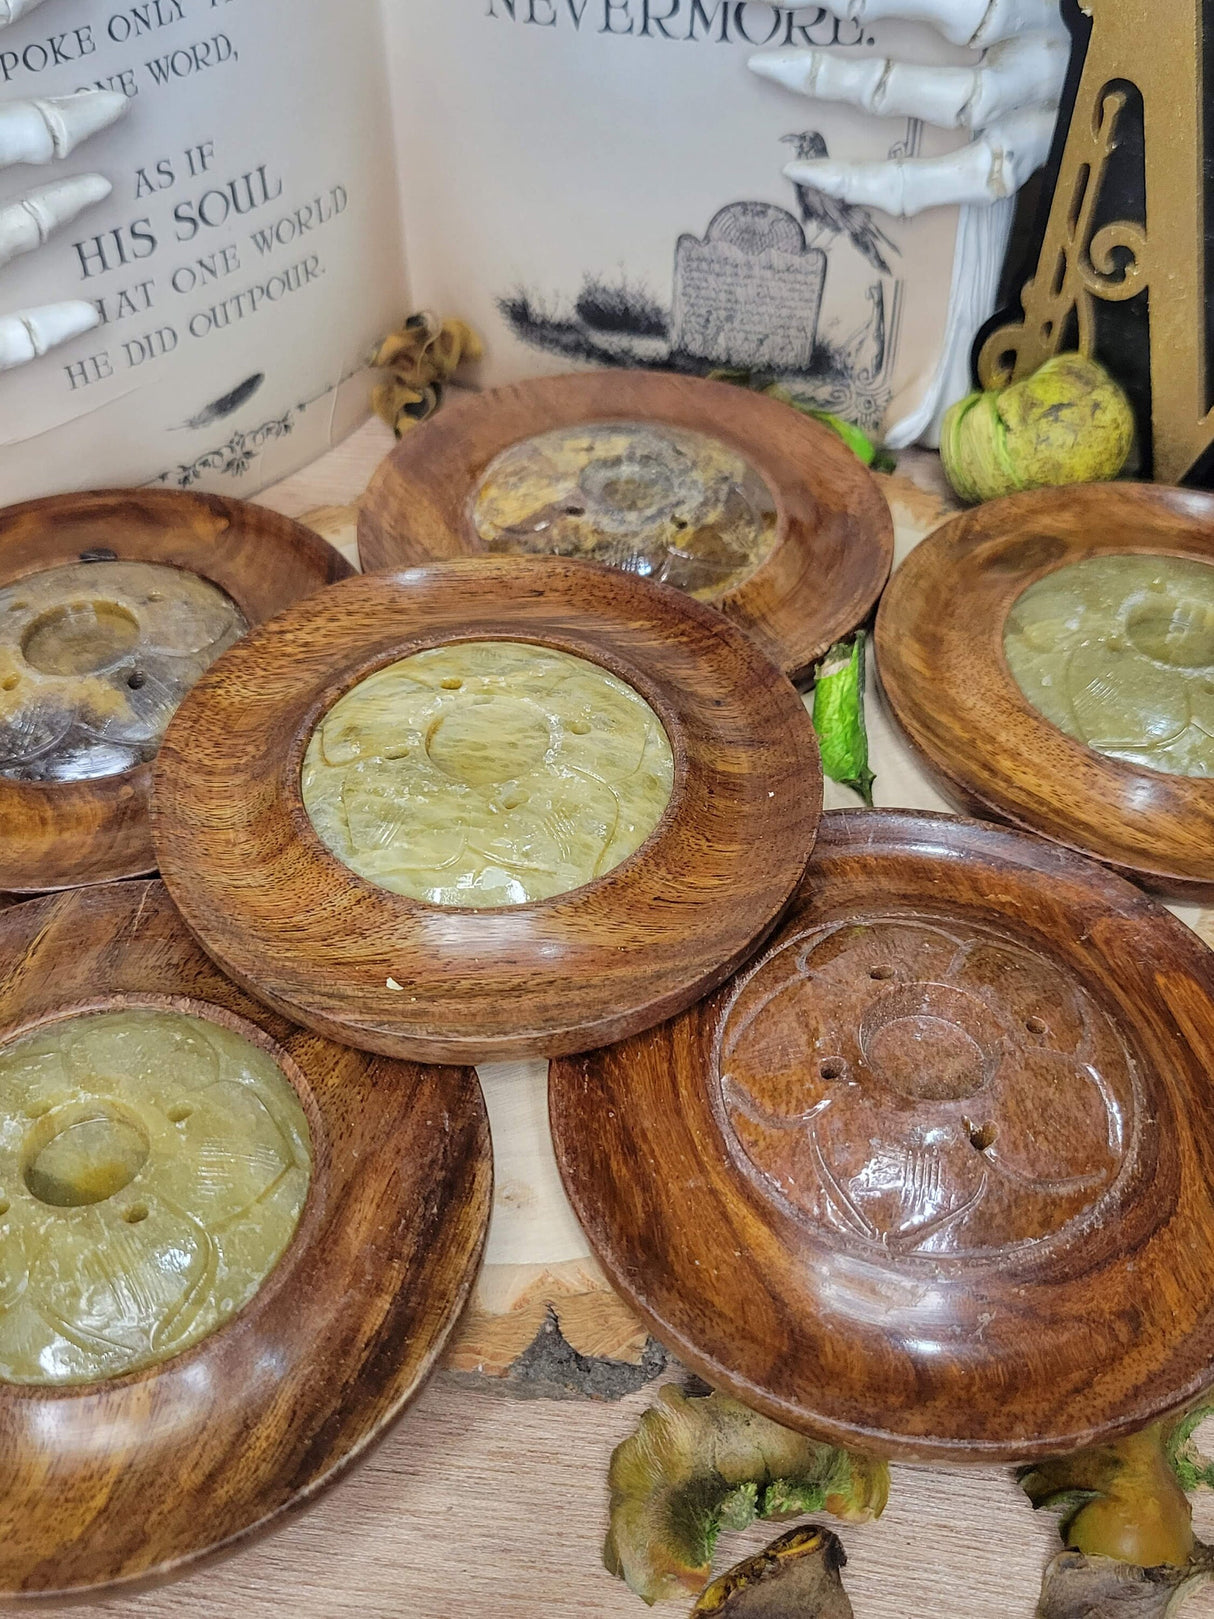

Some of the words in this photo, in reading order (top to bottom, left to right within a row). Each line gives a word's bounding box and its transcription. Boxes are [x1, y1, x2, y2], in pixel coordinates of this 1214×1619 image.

[107, 0, 187, 43] ONLY
[144, 34, 239, 85] WORD,
[135, 159, 176, 200] AS
[185, 142, 216, 177] IF
[72, 218, 159, 281] HIS
[174, 165, 284, 242] SOUL
[172, 244, 241, 294] ONE
[250, 183, 349, 255] WORLD
[63, 351, 115, 391] HE
[122, 327, 178, 368] DID
[189, 256, 326, 338] OUTPOUR.
